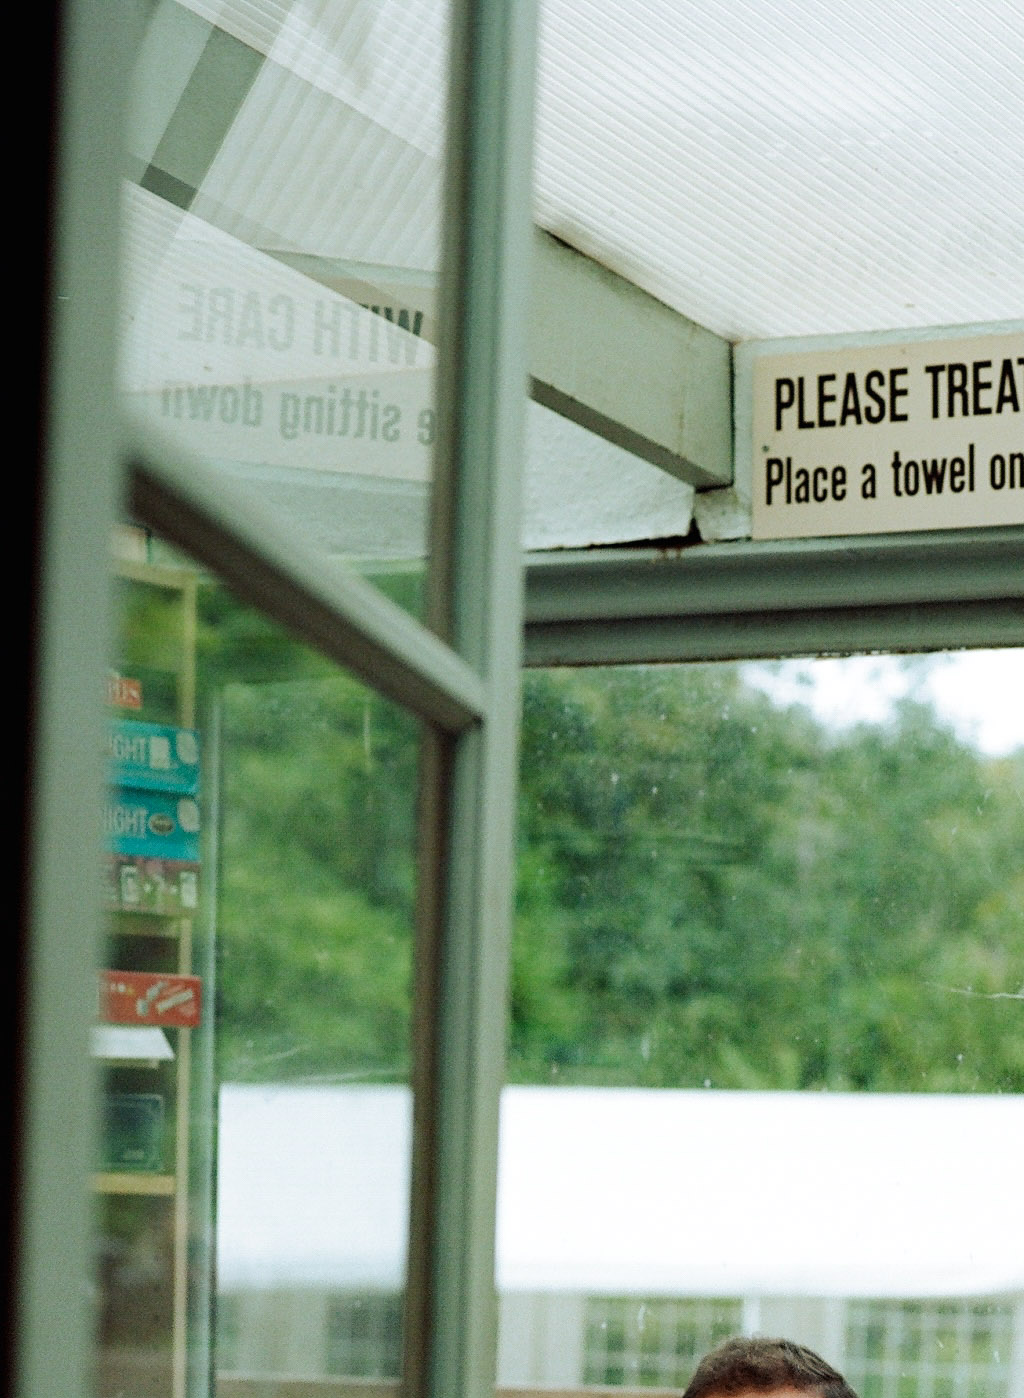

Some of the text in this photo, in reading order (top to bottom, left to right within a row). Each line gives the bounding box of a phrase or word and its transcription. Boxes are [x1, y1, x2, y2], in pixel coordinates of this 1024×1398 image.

[775, 367, 908, 431] PLEASE
[766, 456, 847, 505] Place
[861, 463, 877, 499] a
[891, 443, 975, 497] towel
[990, 452, 1024, 490] on
